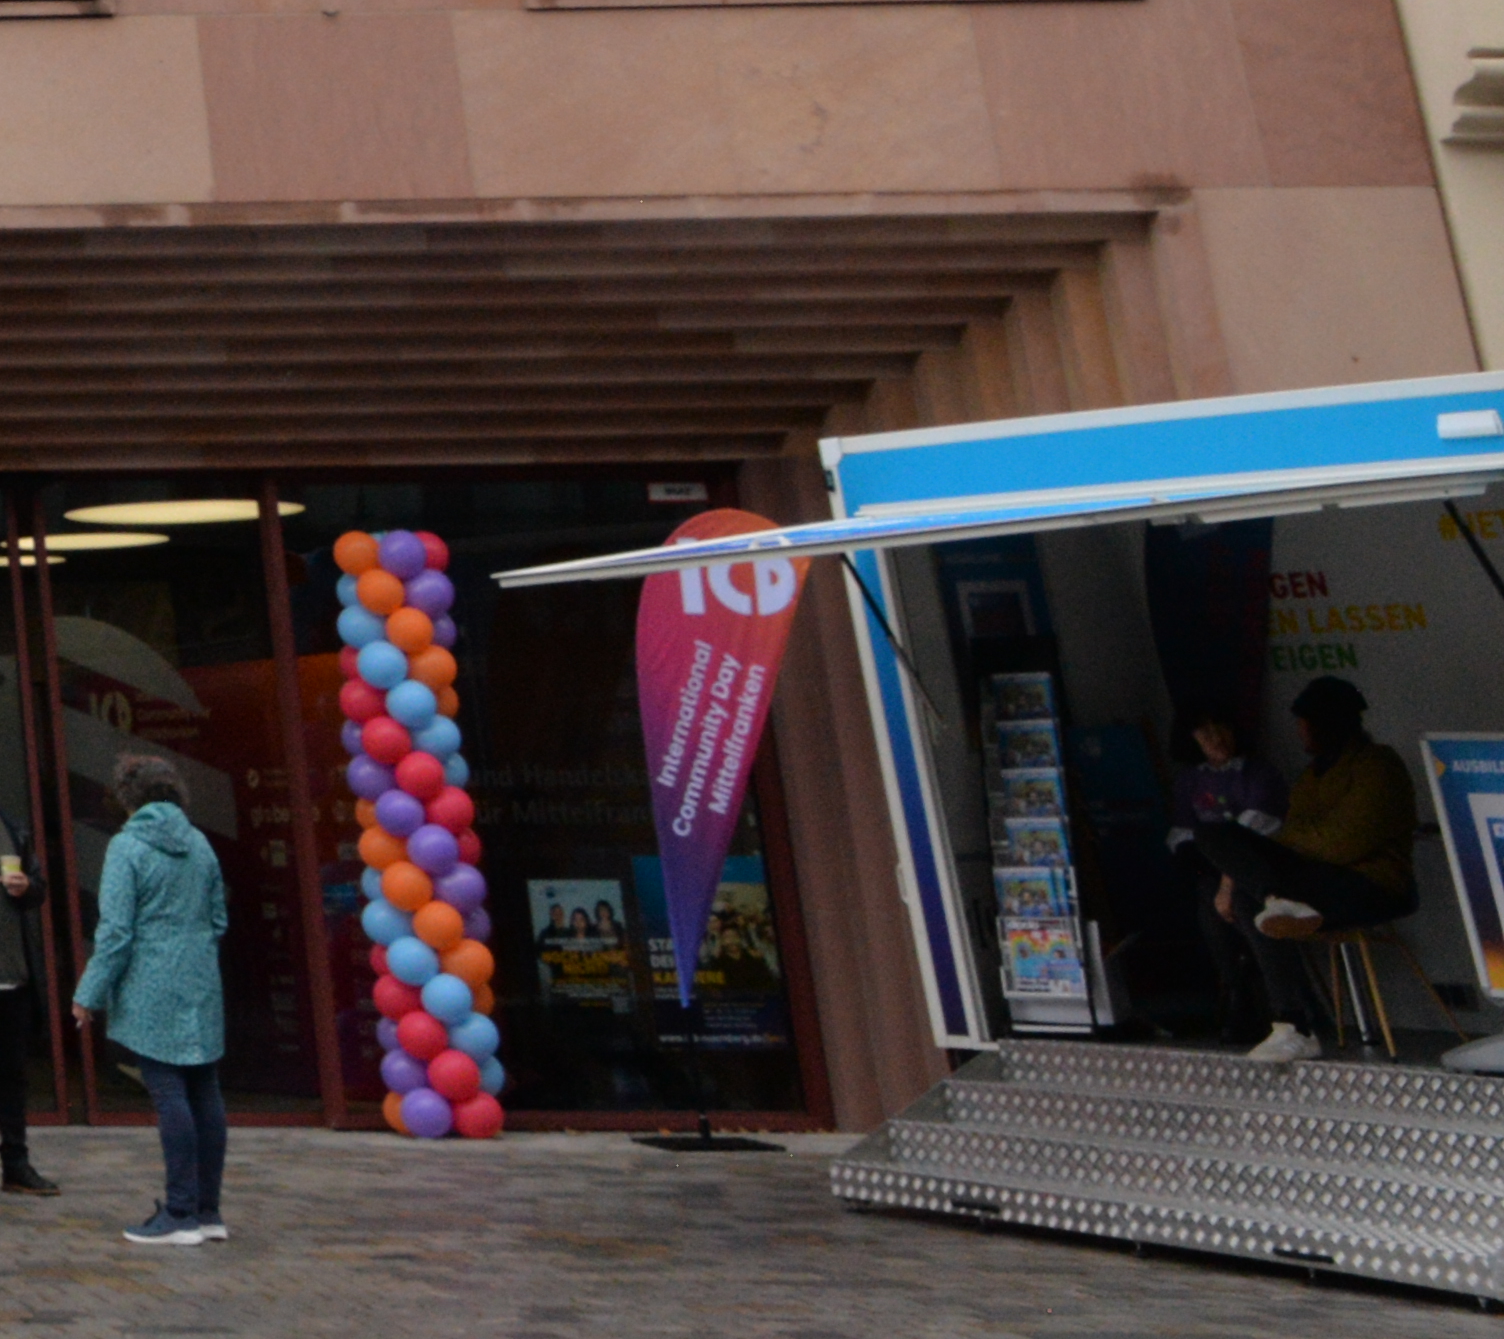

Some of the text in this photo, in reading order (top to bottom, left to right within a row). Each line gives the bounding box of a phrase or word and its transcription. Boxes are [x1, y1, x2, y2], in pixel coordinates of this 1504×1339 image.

[1307, 603, 1427, 634] LASSEN
[656, 639, 713, 789] International
[672, 652, 743, 838] Community Day
[708, 663, 766, 816] Mittelfranken
